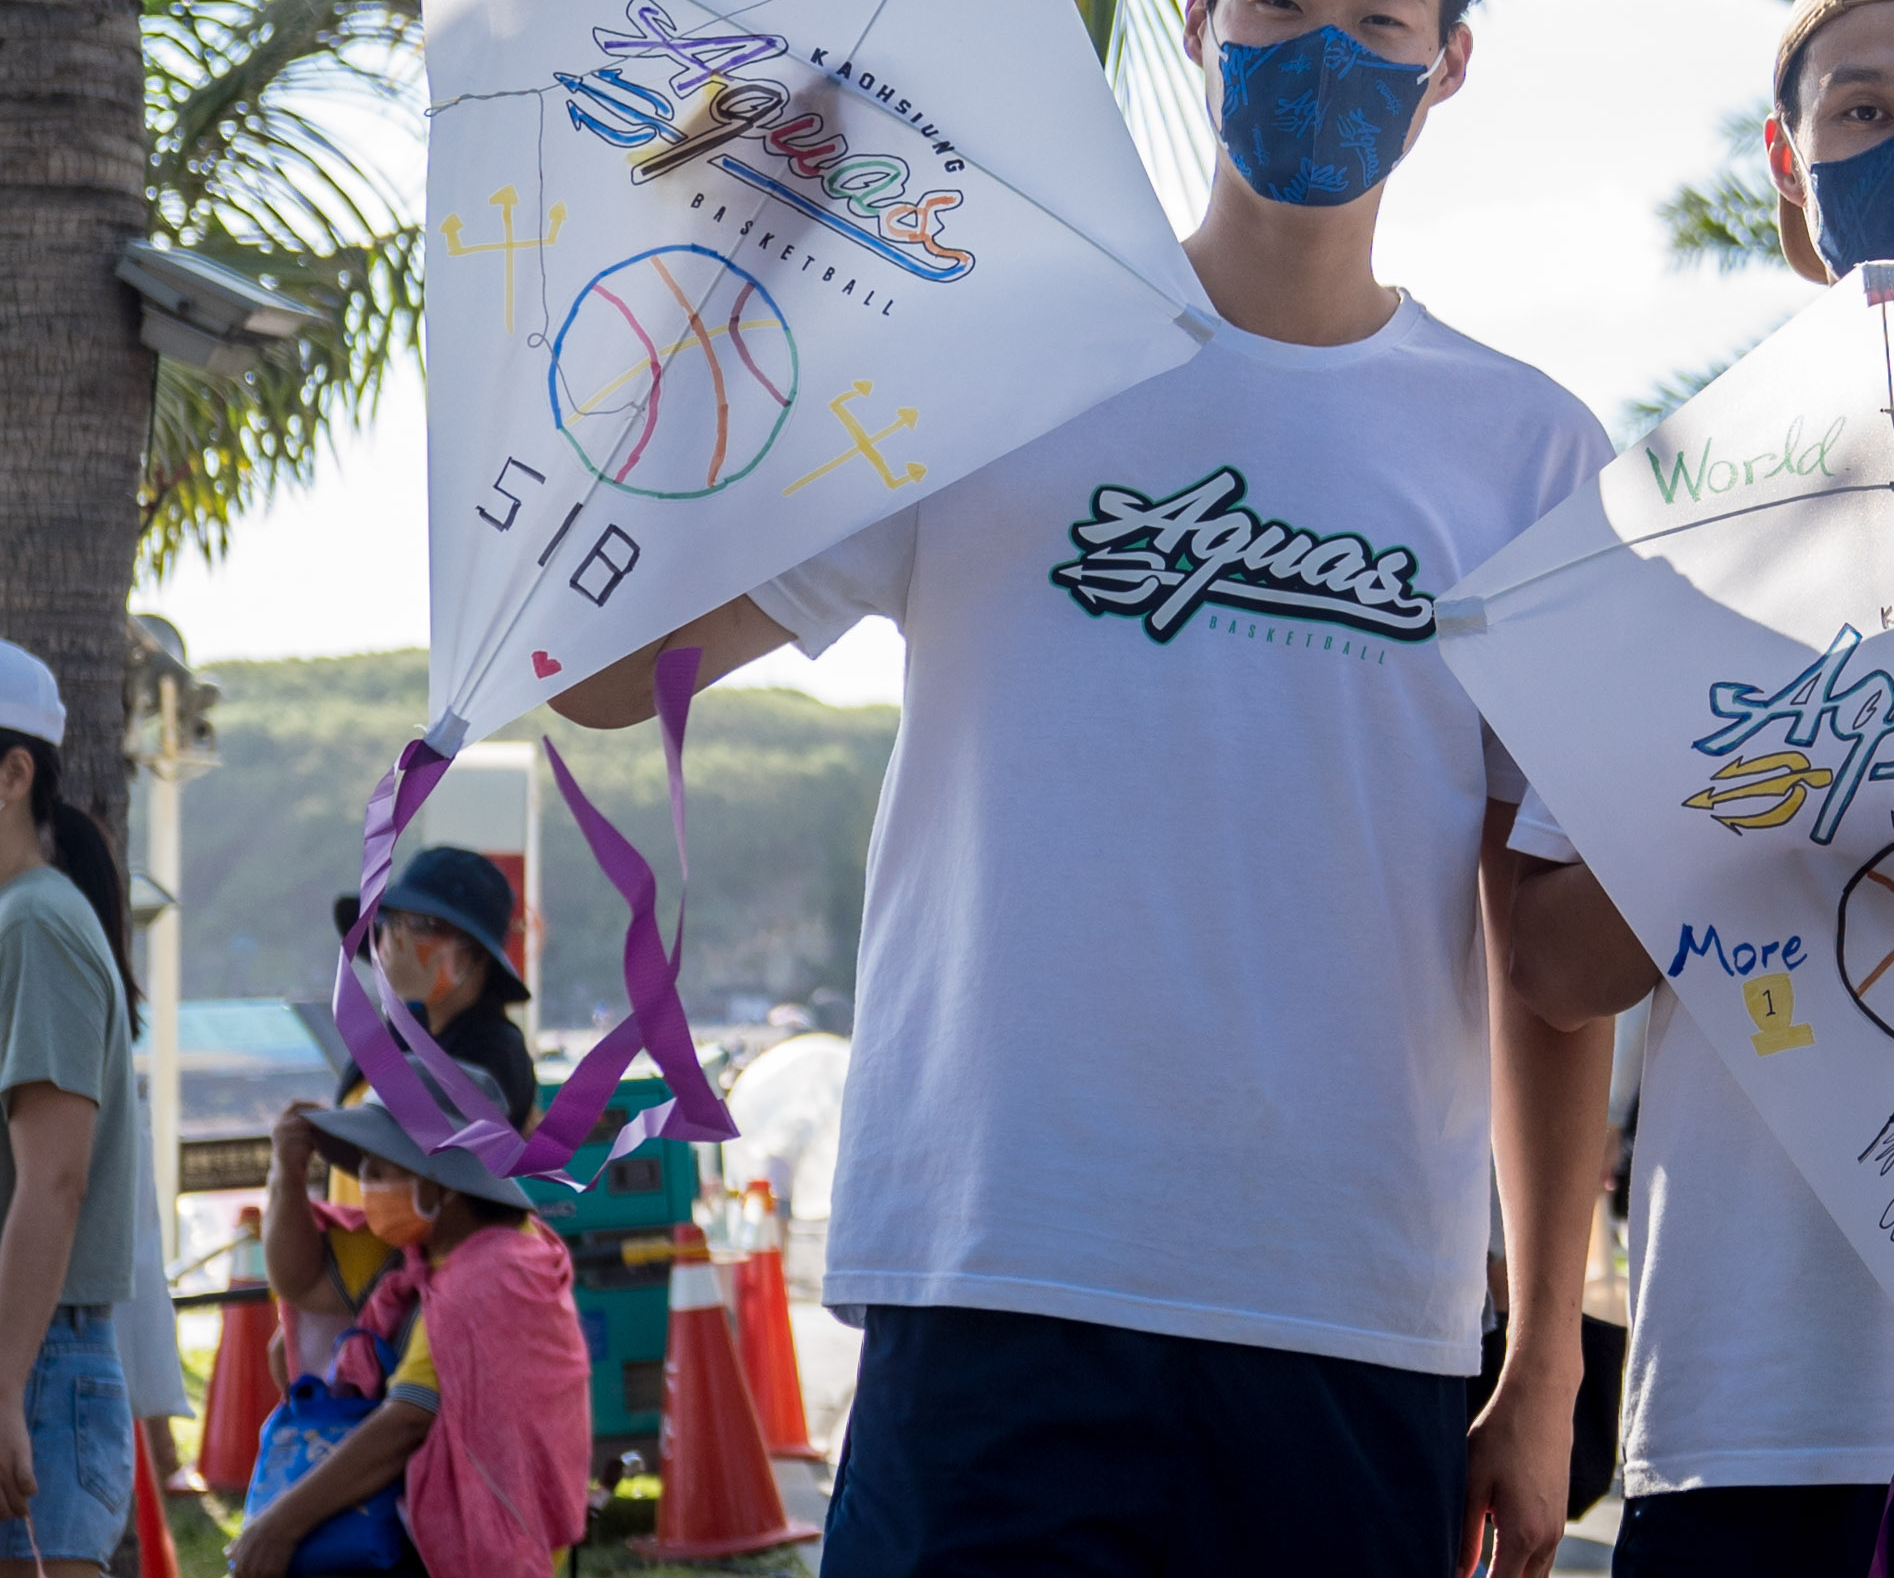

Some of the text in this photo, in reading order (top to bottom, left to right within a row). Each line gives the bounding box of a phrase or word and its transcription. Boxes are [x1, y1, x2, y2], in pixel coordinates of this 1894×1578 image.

[809, 46, 967, 174] KAOHSIUNG
[690, 192, 895, 317] BASKETBALL
[1066, 464, 1438, 647] Aquas
[1208, 614, 1386, 665] BASKETBALL
[1667, 923, 1808, 977] More
[1762, 989, 1776, 1017] 1
